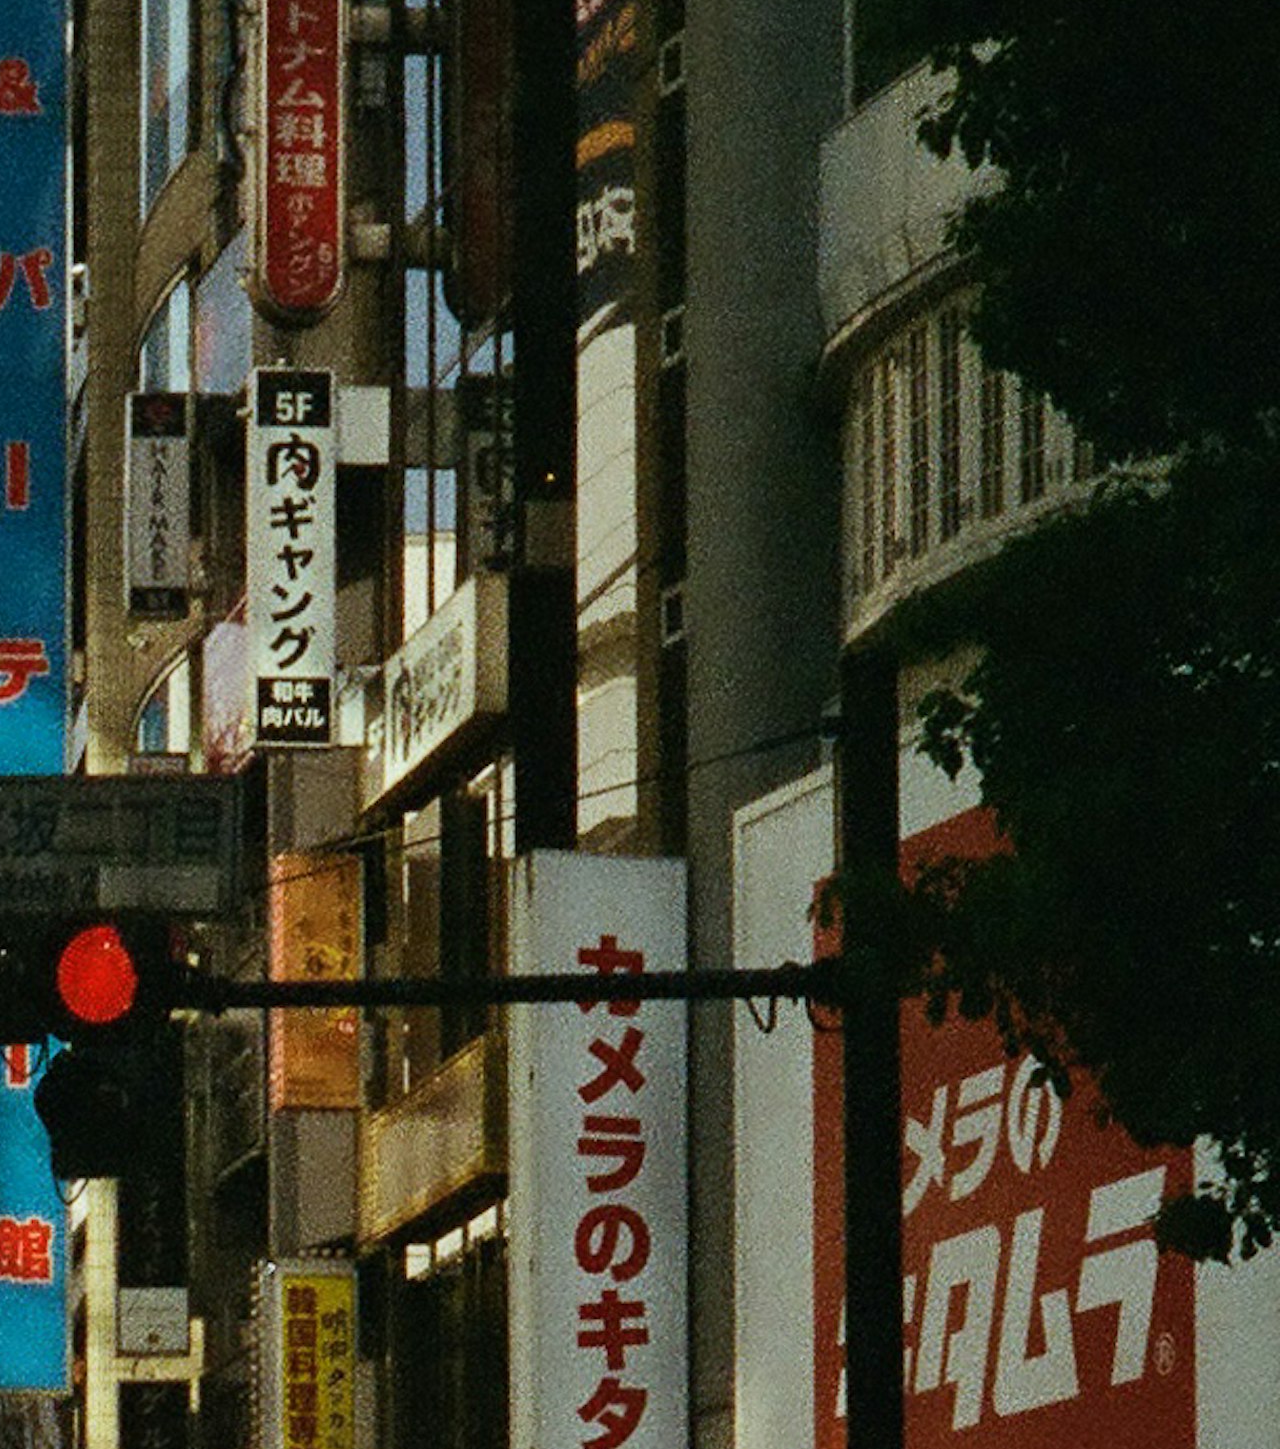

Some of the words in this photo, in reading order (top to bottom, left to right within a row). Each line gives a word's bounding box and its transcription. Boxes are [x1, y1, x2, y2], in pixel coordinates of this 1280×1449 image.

[276, 392, 313, 423] 5F
[265, 438, 321, 673] 肉ギャング
[271, 681, 315, 704] 和牛
[261, 705, 324, 730] 肉バル
